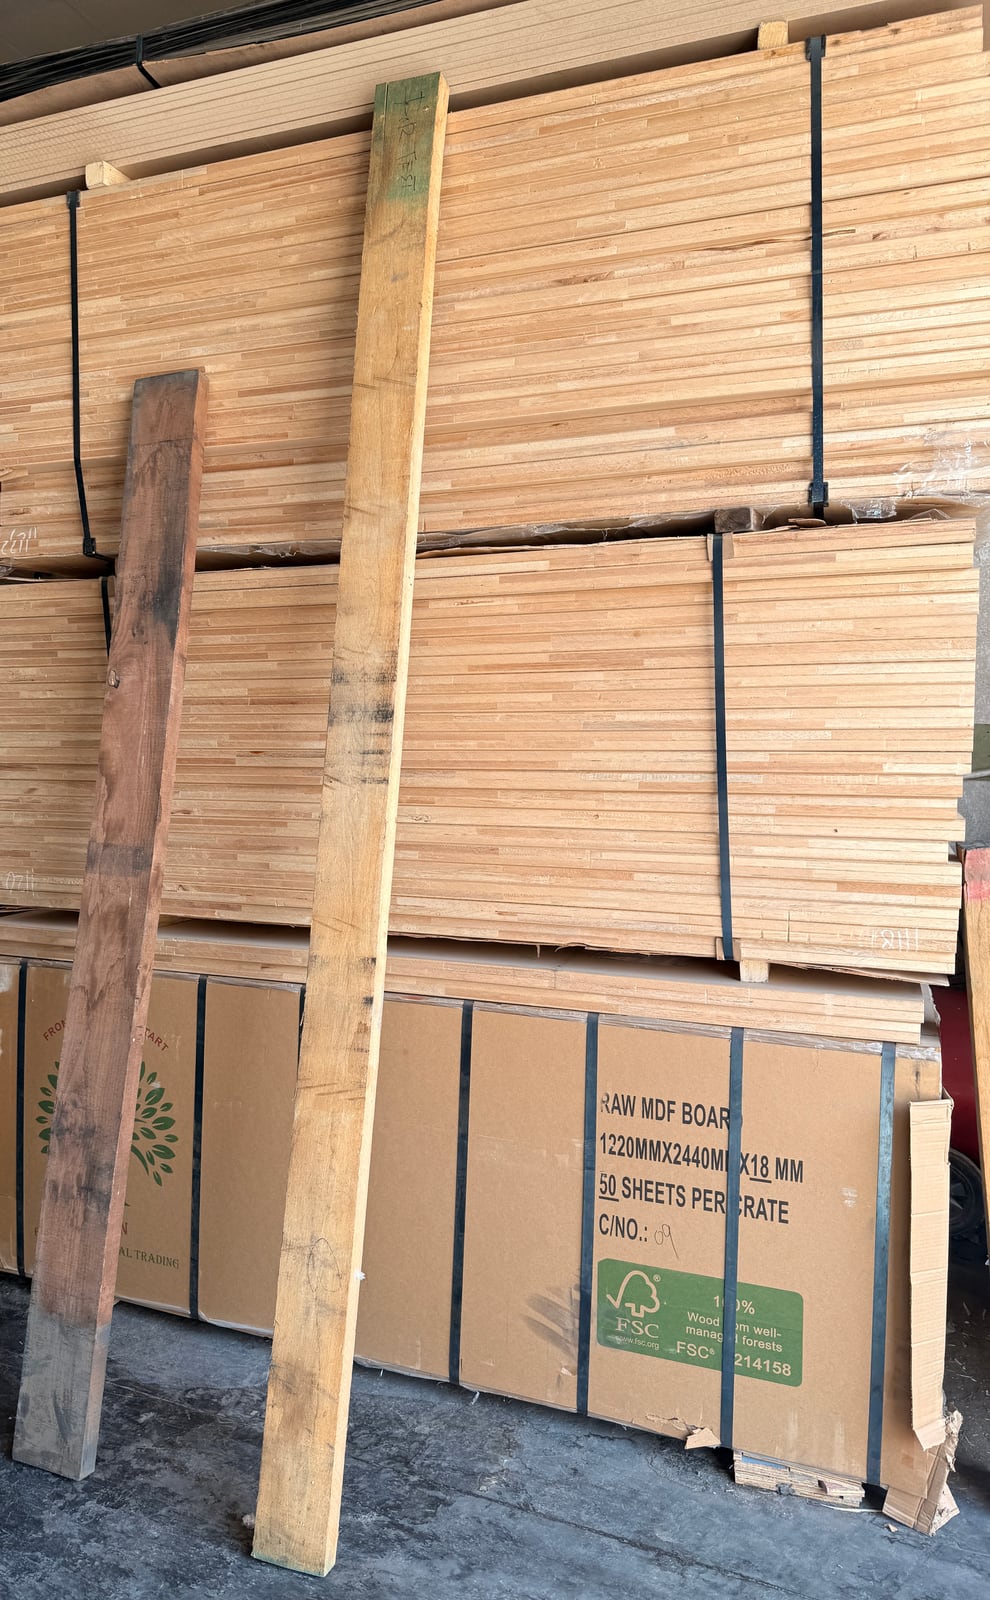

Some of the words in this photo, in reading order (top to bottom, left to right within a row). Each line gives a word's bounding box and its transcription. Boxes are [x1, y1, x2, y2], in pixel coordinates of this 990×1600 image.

[144, 1027, 169, 1051] TART
[600, 1092, 636, 1117] RAW
[641, 1097, 676, 1122] MDF
[682, 1102, 743, 1131] BOAR
[775, 1157, 804, 1184] MM
[599, 1172, 617, 1198] 50
[622, 1176, 686, 1207] SHEETS
[692, 1187, 726, 1214] PER
[599, 1213, 648, 1242] C/NO.:
[134, 1249, 180, 1270] TRADING
[615, 1316, 660, 1339] FSC
[687, 1311, 720, 1327] Wood
[753, 1324, 782, 1339] well-
[742, 1336, 783, 1353] forests
[734, 1353, 792, 1377] 214158
